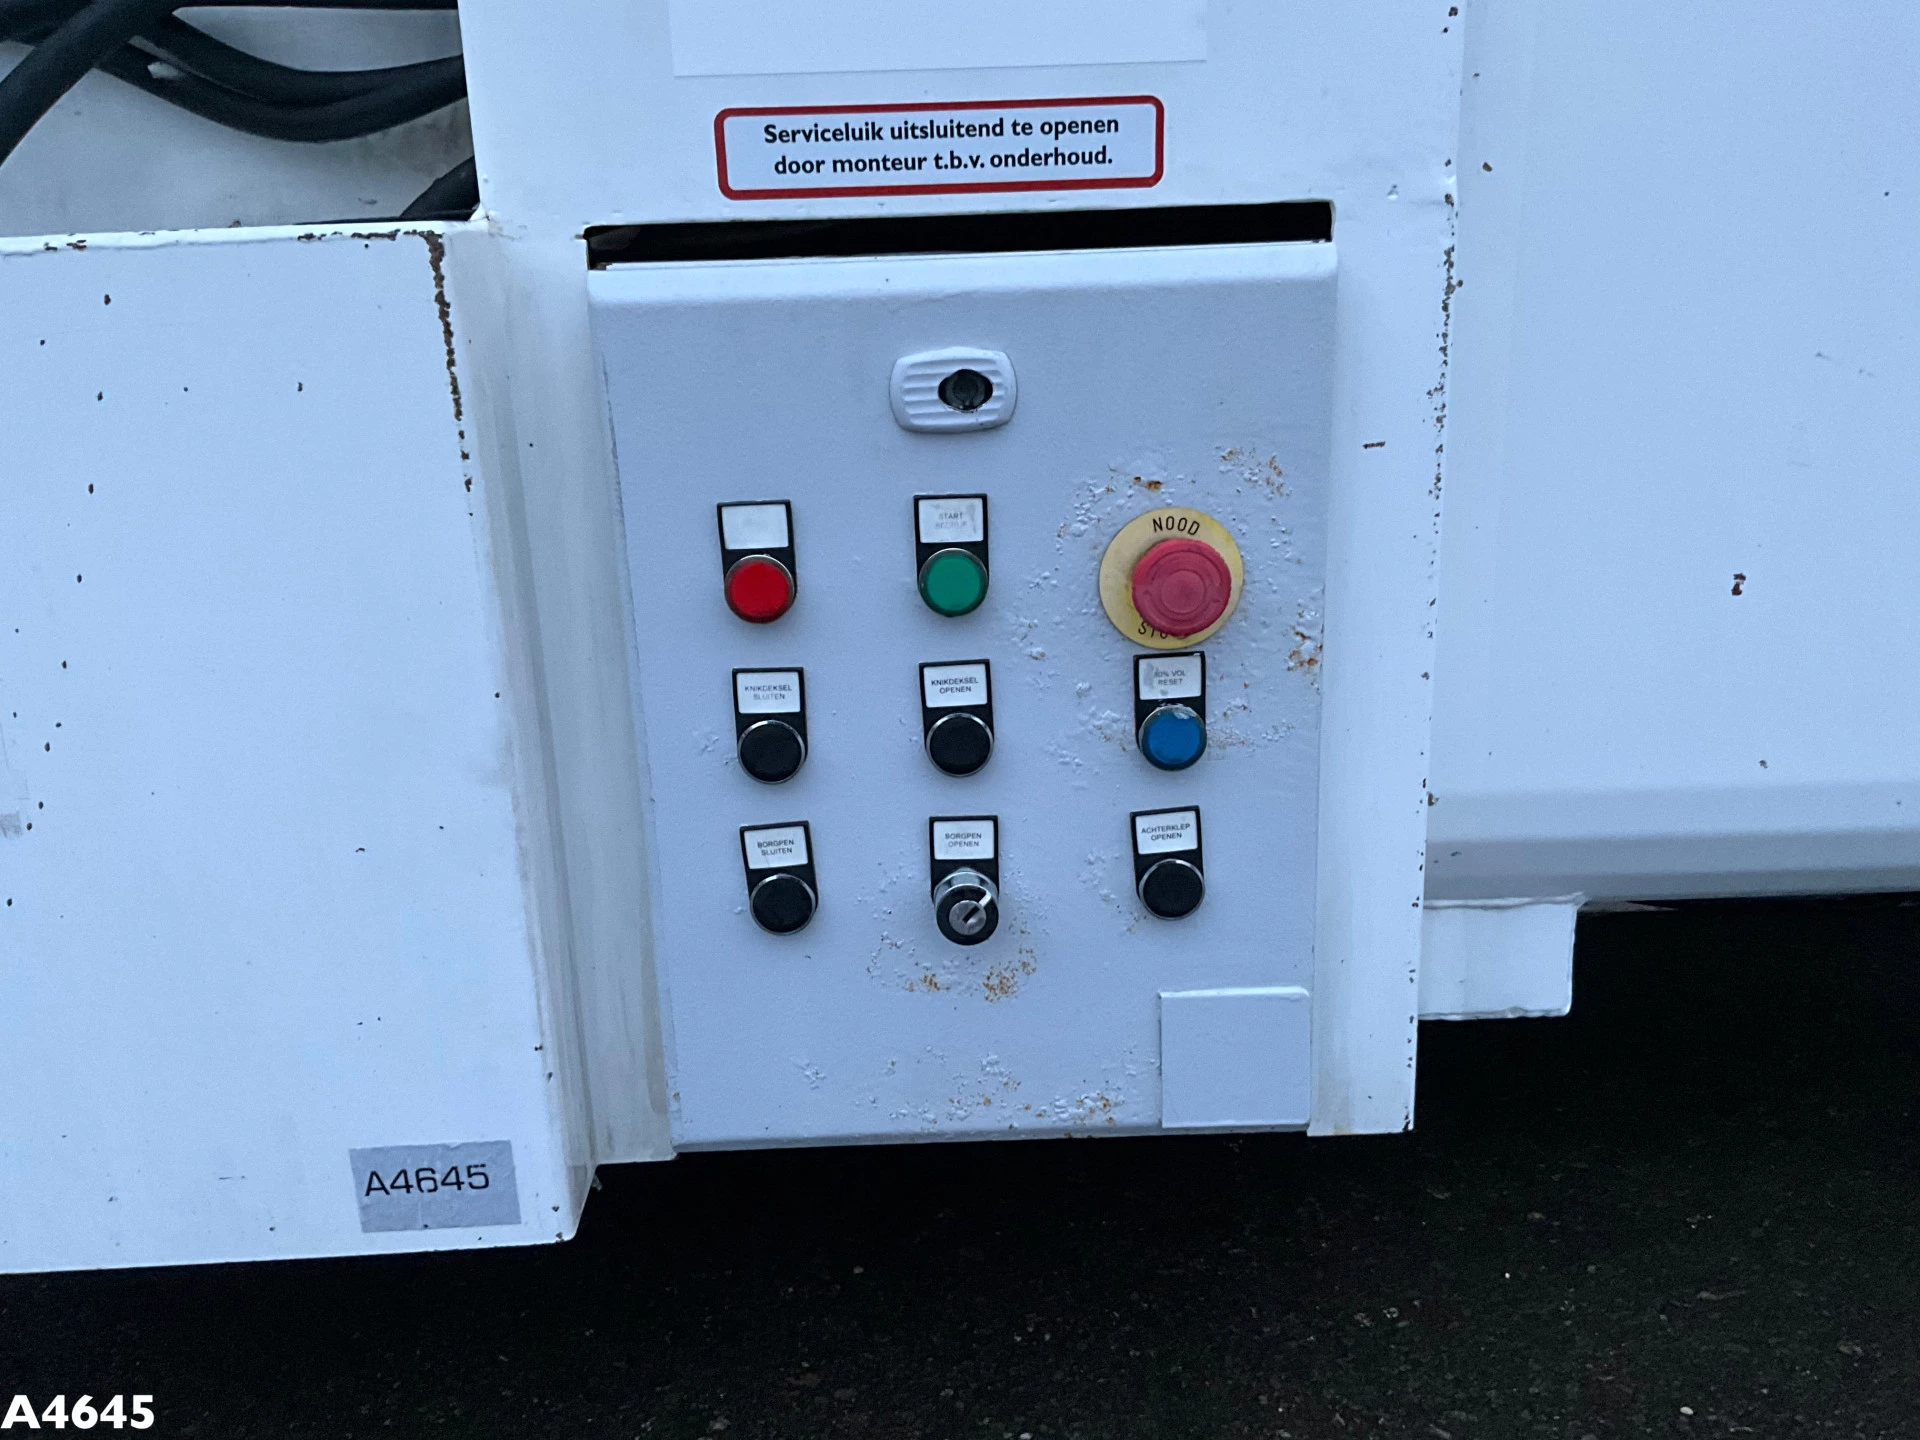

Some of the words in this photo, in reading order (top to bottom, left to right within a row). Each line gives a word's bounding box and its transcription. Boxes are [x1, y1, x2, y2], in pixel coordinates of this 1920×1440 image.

[764, 121, 884, 144] Serviceluik
[890, 117, 1004, 141] uitsluitend
[1011, 118, 1034, 137] te
[1040, 118, 1119, 141] openen
[774, 155, 826, 175] door
[832, 153, 928, 173] monteur
[933, 150, 986, 170] t.b.v.
[990, 144, 1114, 169] onderhoud.
[1152, 515, 1201, 536] NOOD
[1171, 669, 1187, 677] VOL
[931, 676, 979, 686] KNIKDEKSEL
[1158, 678, 1184, 686] RESET
[744, 684, 793, 692] KNIKDEKSEL
[939, 686, 972, 694] OPENEN
[753, 693, 786, 701] SLUITEN
[1141, 823, 1191, 834] ACHTERKLEP
[944, 832, 982, 840] BORGPEN
[1150, 832, 1182, 841] OPENEN
[757, 839, 795, 849] BORGPEN
[761, 847, 793, 856] SLUITEN
[365, 1163, 490, 1197] A4645
